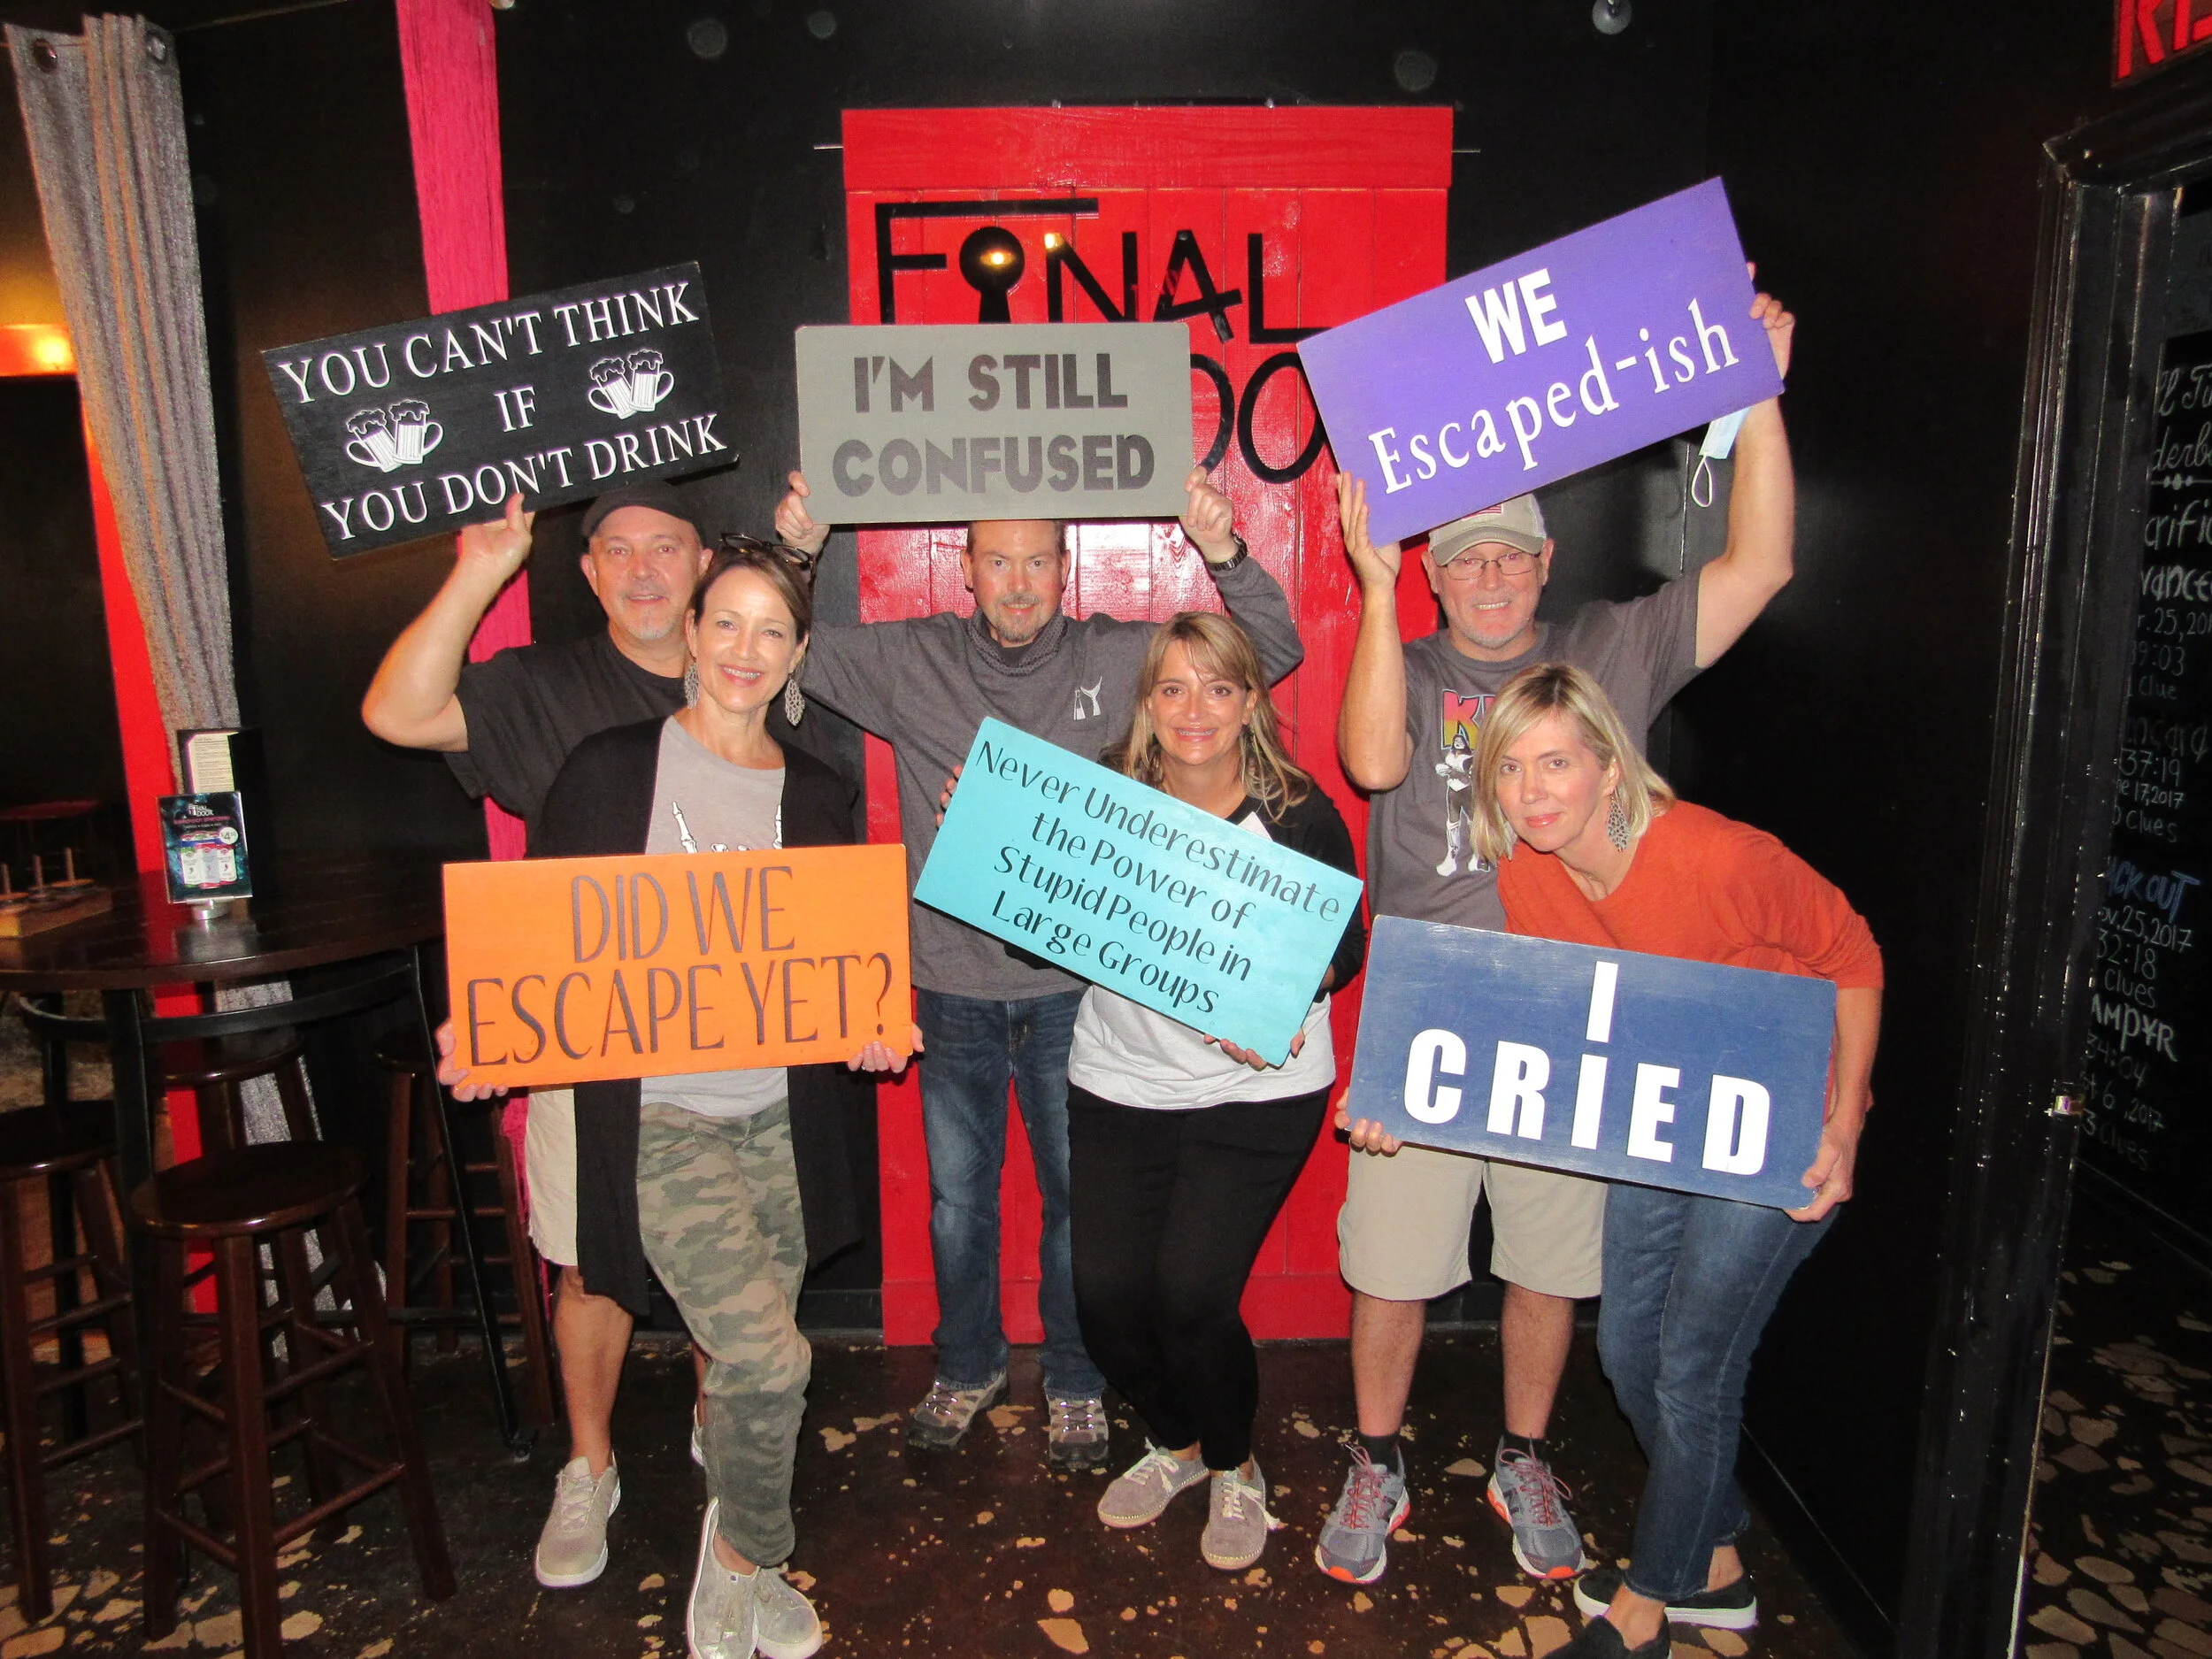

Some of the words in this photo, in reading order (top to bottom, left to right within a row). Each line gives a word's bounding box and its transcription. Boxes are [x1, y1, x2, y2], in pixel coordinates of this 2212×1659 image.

[874, 197, 1333, 345] FINAL
[1463, 267, 1568, 365] WE
[278, 342, 392, 404] YOU
[404, 312, 542, 379] CAN'T
[554, 281, 700, 348] THINK
[854, 356, 935, 414] I'M
[968, 353, 1129, 412] STILL
[1367, 297, 1740, 495] Escaped-ish
[494, 386, 537, 433] IF
[832, 434, 1156, 498] CONFUSED
[321, 480, 430, 541] YOU
[439, 447, 573, 516] DON'T
[584, 413, 728, 481] DRINK
[975, 740, 1080, 804] Never
[1084, 787, 1340, 923] Underestimate
[1031, 811, 1087, 860] the
[1089, 838, 1208, 910] Power
[1211, 897, 1256, 930] of
[571, 872, 669, 964] DID
[686, 865, 795, 956] WE
[991, 890, 1092, 958] Large
[1098, 940, 1220, 1016] Groups
[994, 845, 1109, 921] Stupid
[1106, 893, 1216, 965] People
[1218, 943, 1253, 981] in
[467, 964, 725, 1067] ESCAPE
[741, 952, 893, 1047] YET?
[1586, 960, 1619, 1044] I
[1403, 1027, 1771, 1177] CRIED
